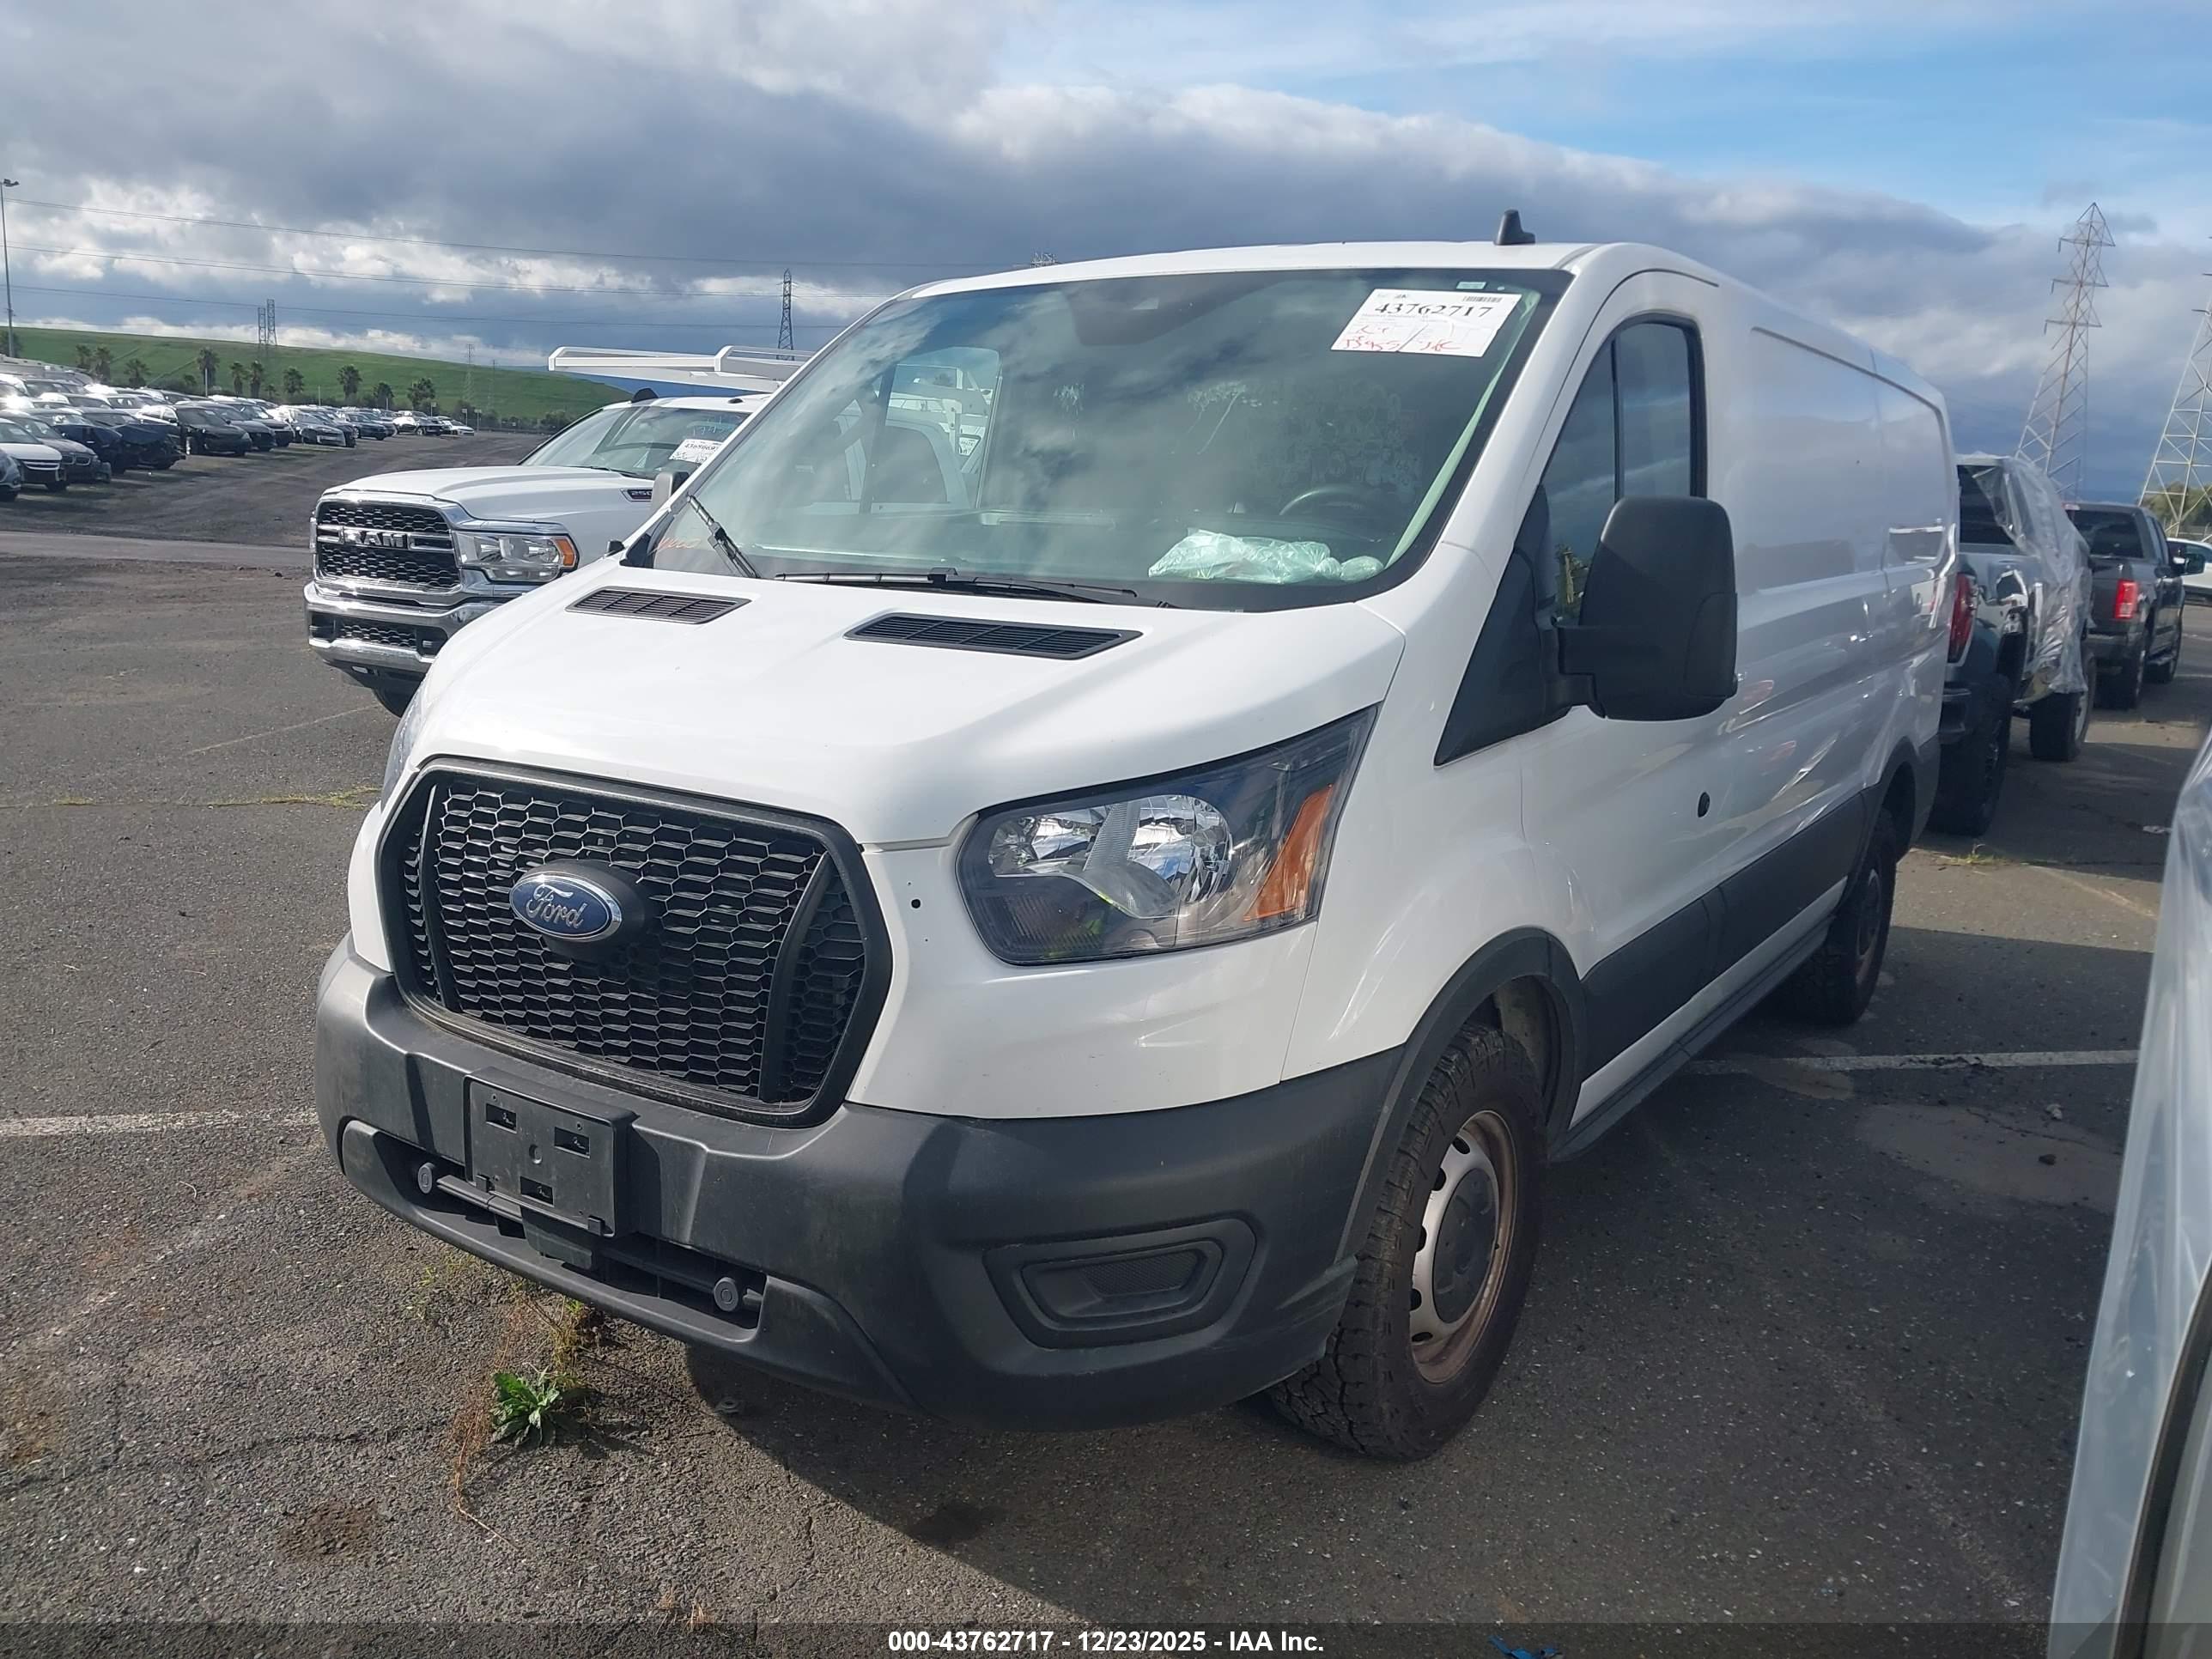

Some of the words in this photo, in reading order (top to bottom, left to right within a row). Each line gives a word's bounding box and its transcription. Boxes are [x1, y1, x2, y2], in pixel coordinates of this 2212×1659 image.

[1375, 302, 1493, 318] 43762717
[344, 529, 404, 548] RAM
[526, 884, 588, 929] Ford
